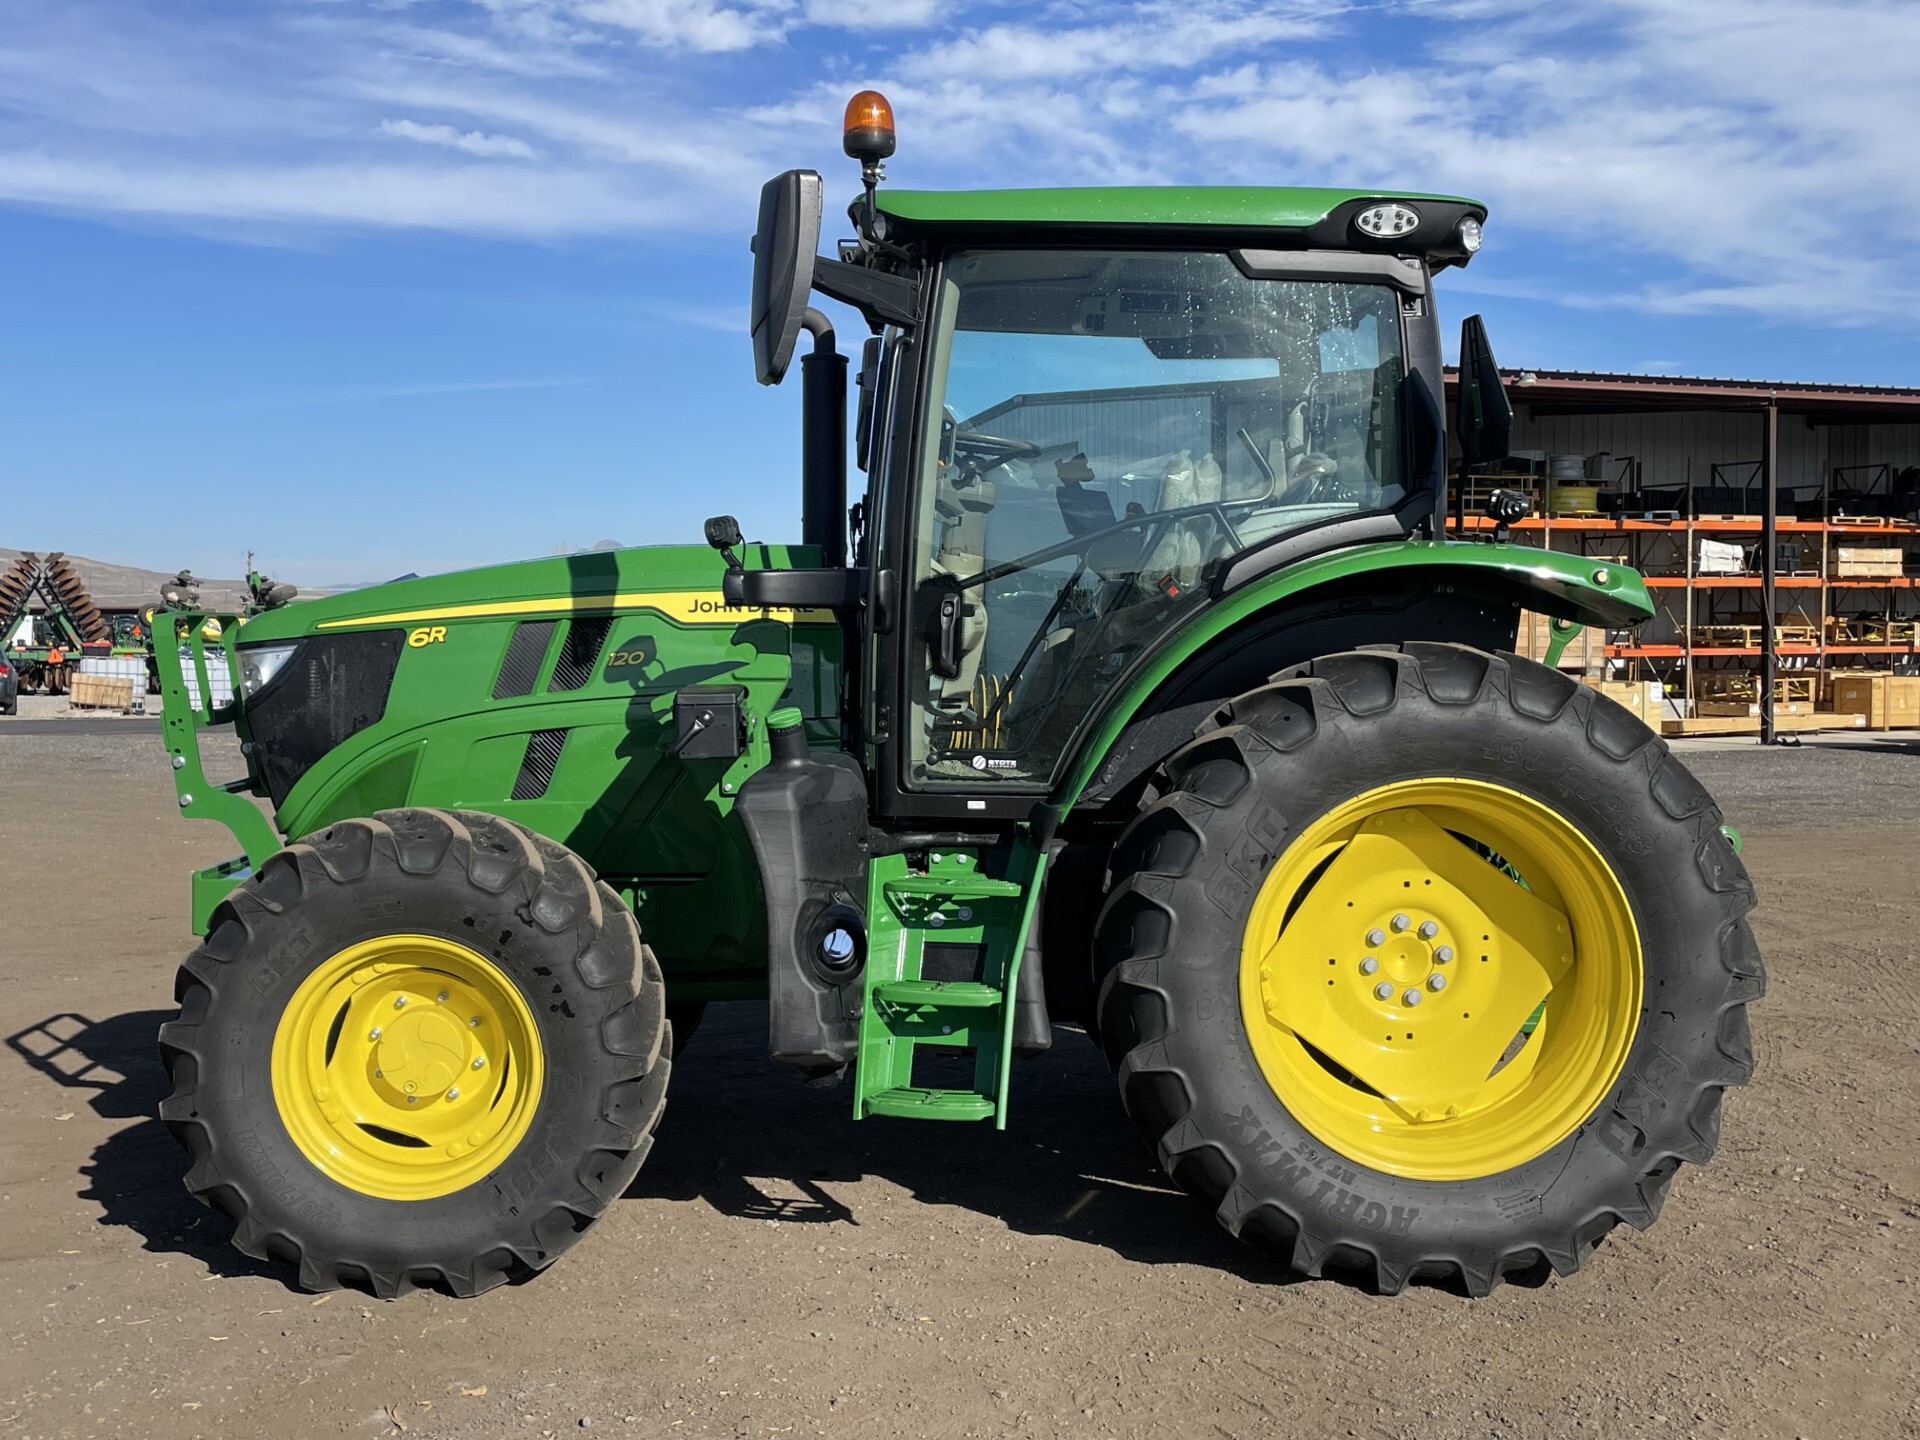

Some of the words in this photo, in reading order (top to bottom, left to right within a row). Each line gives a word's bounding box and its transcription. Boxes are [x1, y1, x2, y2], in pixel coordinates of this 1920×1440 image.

[688, 599, 742, 613] JOHN
[408, 625, 447, 649] 6R
[608, 650, 645, 667] 120
